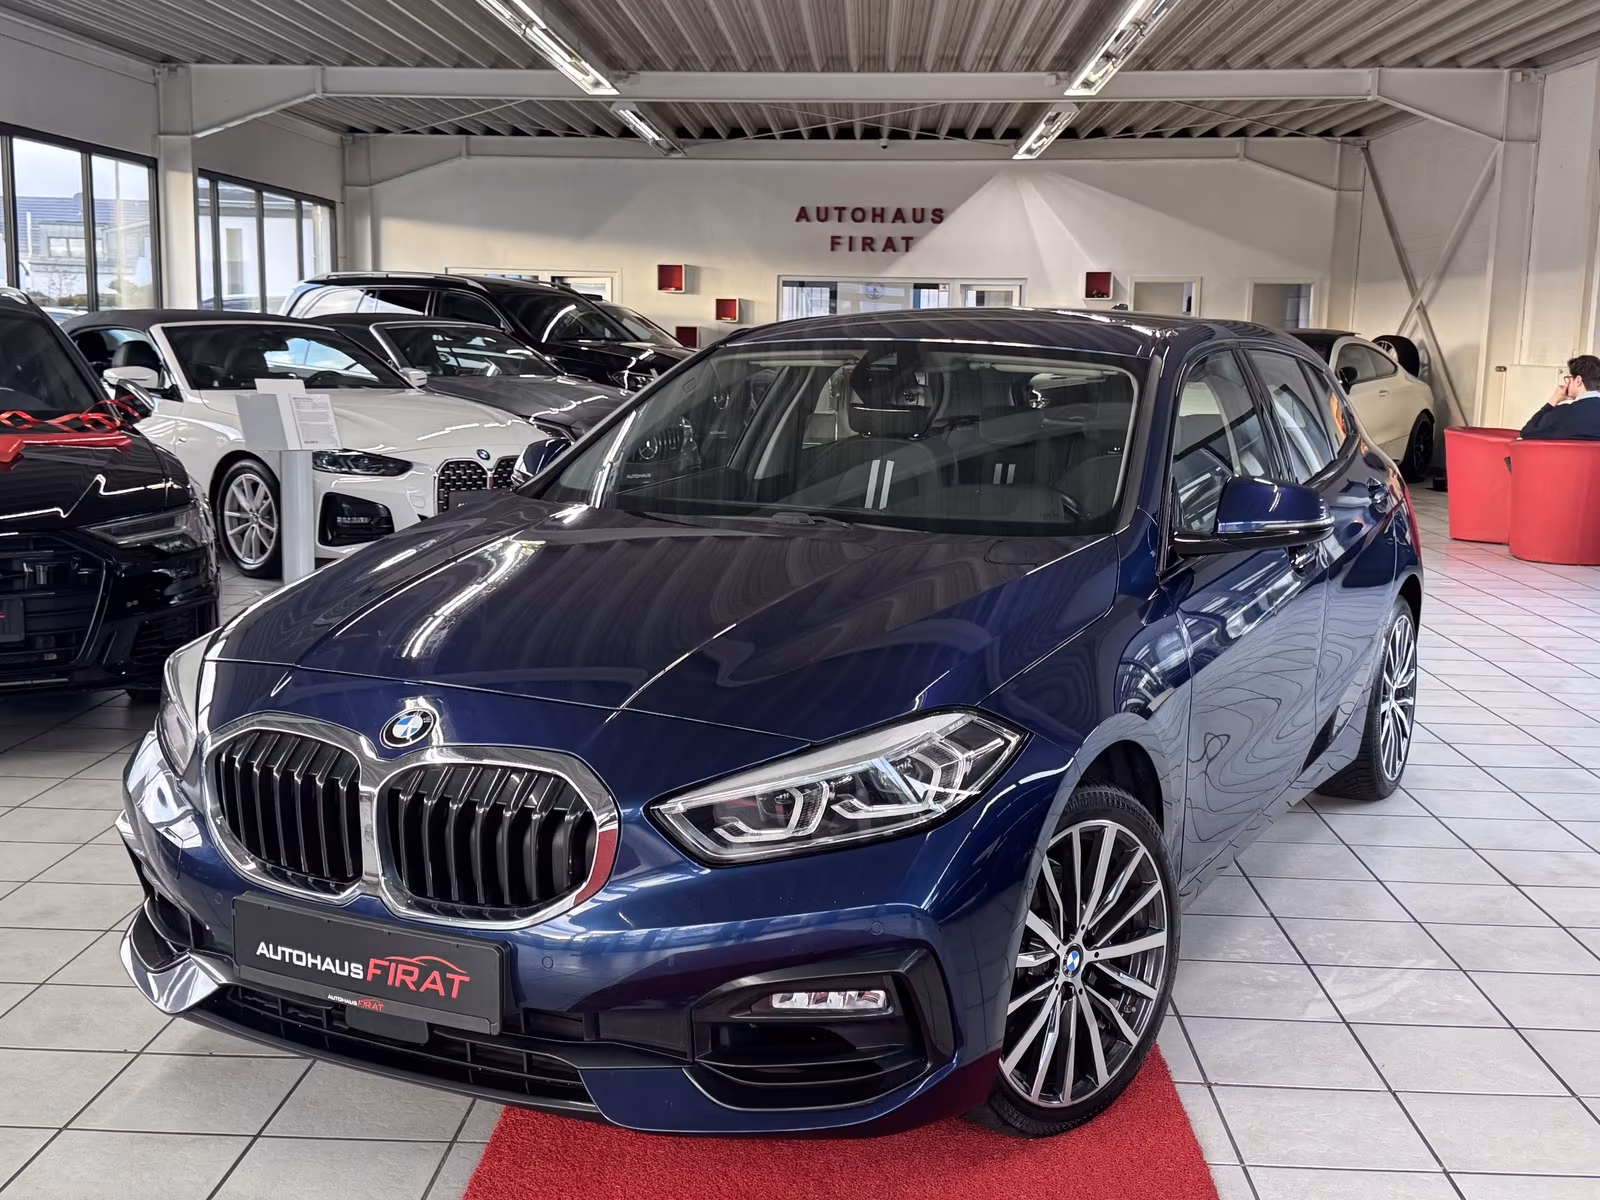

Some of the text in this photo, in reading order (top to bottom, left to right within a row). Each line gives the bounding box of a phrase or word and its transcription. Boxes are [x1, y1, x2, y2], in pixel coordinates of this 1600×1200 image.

[795, 206, 945, 225] AUTOHAUS
[830, 235, 914, 252] FIRAT
[256, 941, 471, 999] AUTOHAUS FIRAT
[327, 994, 384, 1011] AUTOHAUS FIRAT
